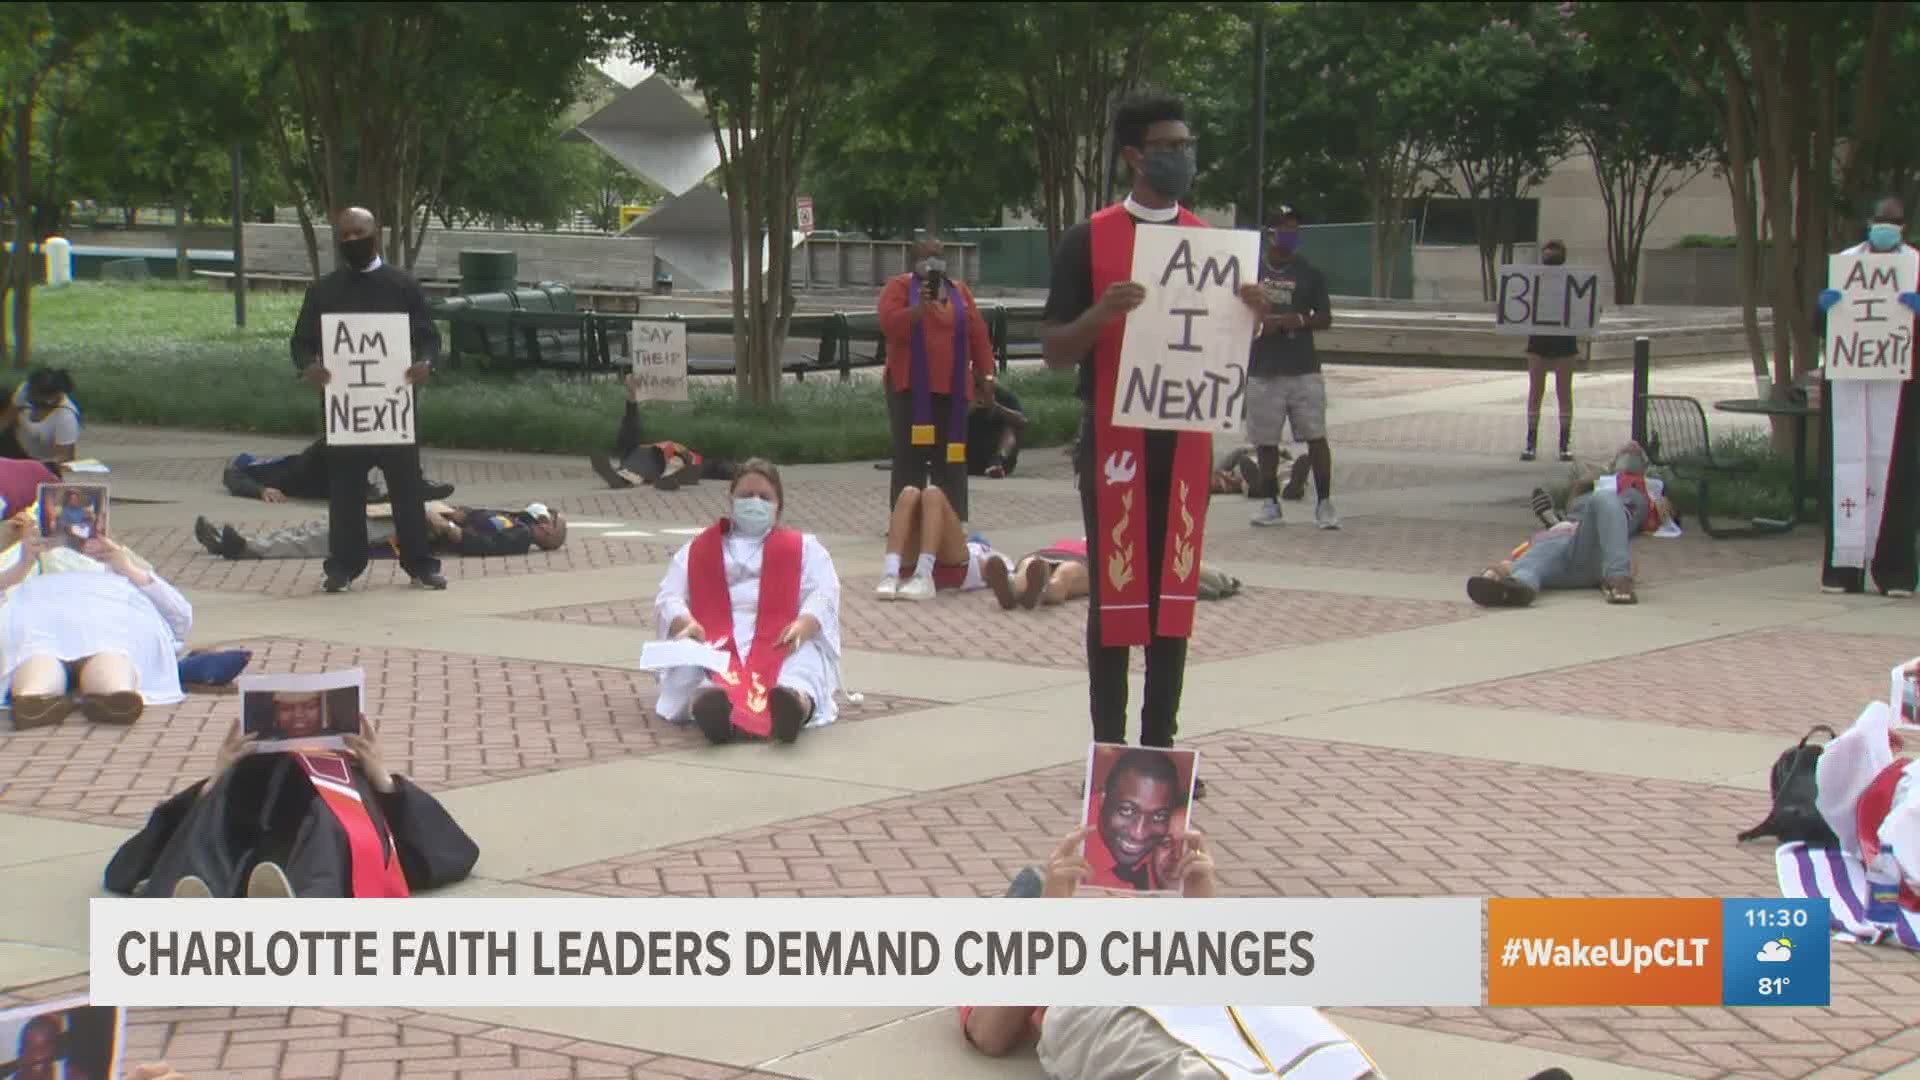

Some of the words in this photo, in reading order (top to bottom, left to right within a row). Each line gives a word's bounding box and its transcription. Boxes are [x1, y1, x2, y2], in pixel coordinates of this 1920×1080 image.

[1160, 239, 1241, 297] AM
[1844, 259, 1899, 292] AM
[1498, 272, 1597, 328] BLM
[1852, 298, 1888, 322] I
[333, 319, 388, 357] AM
[640, 326, 673, 344] SAY
[1168, 308, 1209, 352] I
[1832, 325, 1911, 374] NEXT?
[347, 360, 386, 388] I
[1121, 363, 1245, 428] NEXT?
[330, 385, 411, 440] NEXT?
